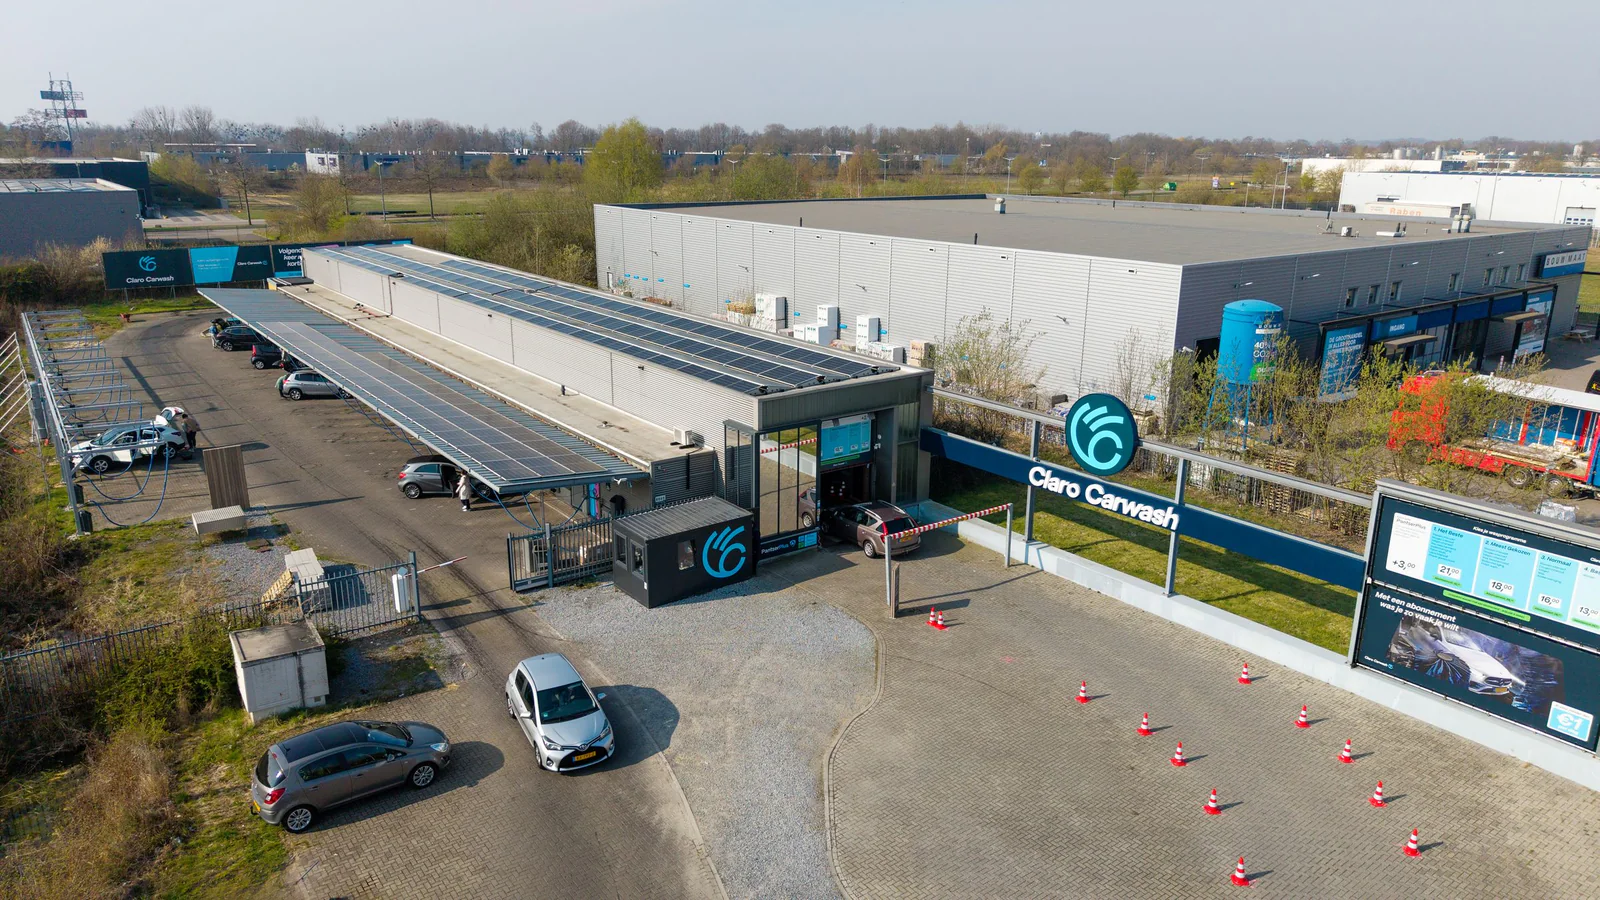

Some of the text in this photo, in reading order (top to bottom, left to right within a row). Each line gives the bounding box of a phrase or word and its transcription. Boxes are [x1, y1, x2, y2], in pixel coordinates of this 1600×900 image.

[1390, 208, 1422, 216] Raben
[1028, 466, 1180, 530] Claro Carwash
[1448, 530, 1463, 538] Beste
[1491, 542, 1507, 550] Meest
[1508, 545, 1530, 556] Gekozen
[1393, 560, 1415, 570] +3,00
[1547, 557, 1572, 566] Normaal
[1440, 566, 1459, 576] 21,00
[1492, 581, 1512, 592] 18,00
[1541, 596, 1559, 605] 16,00
[1375, 592, 1456, 622] Met een abonnement
[1580, 607, 1598, 616] 13,00
[1380, 602, 1395, 610] was
[1415, 613, 1434, 623] vaak
[1434, 619, 1443, 627] je
[1444, 623, 1459, 632] wilt
[1556, 713, 1583, 730] €1
